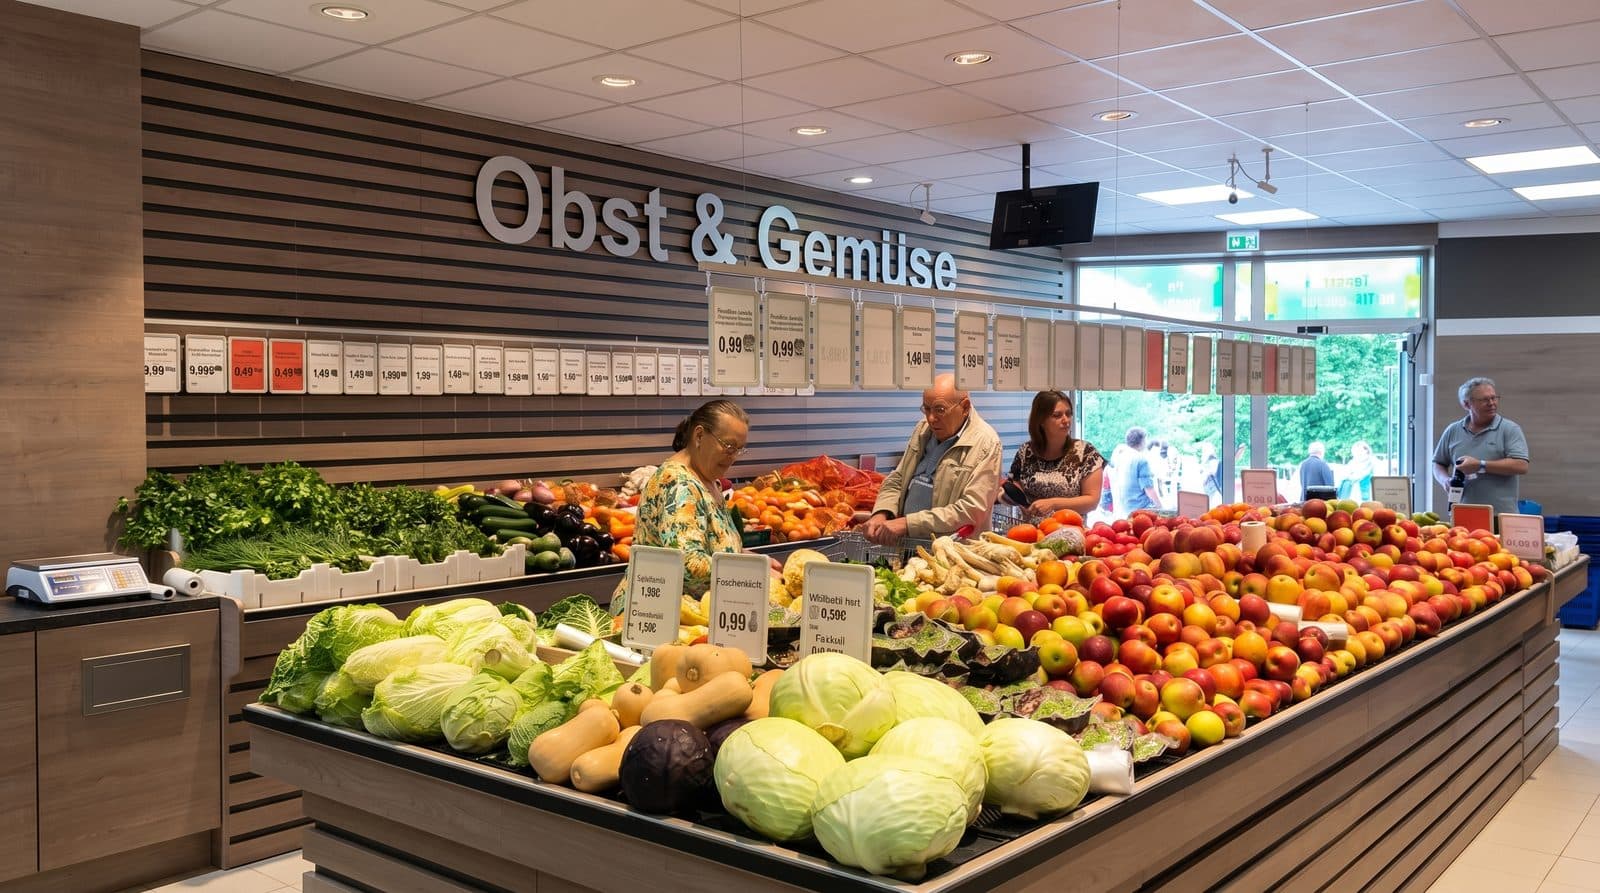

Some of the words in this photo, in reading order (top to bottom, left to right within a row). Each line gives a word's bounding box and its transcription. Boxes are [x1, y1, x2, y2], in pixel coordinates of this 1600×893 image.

[474, 154, 671, 263] Obst
[691, 191, 739, 265] &
[757, 204, 959, 293] Gemüse
[718, 335, 743, 354] 0,99
[771, 340, 795, 358] 0,99
[719, 611, 747, 632] 0,99
